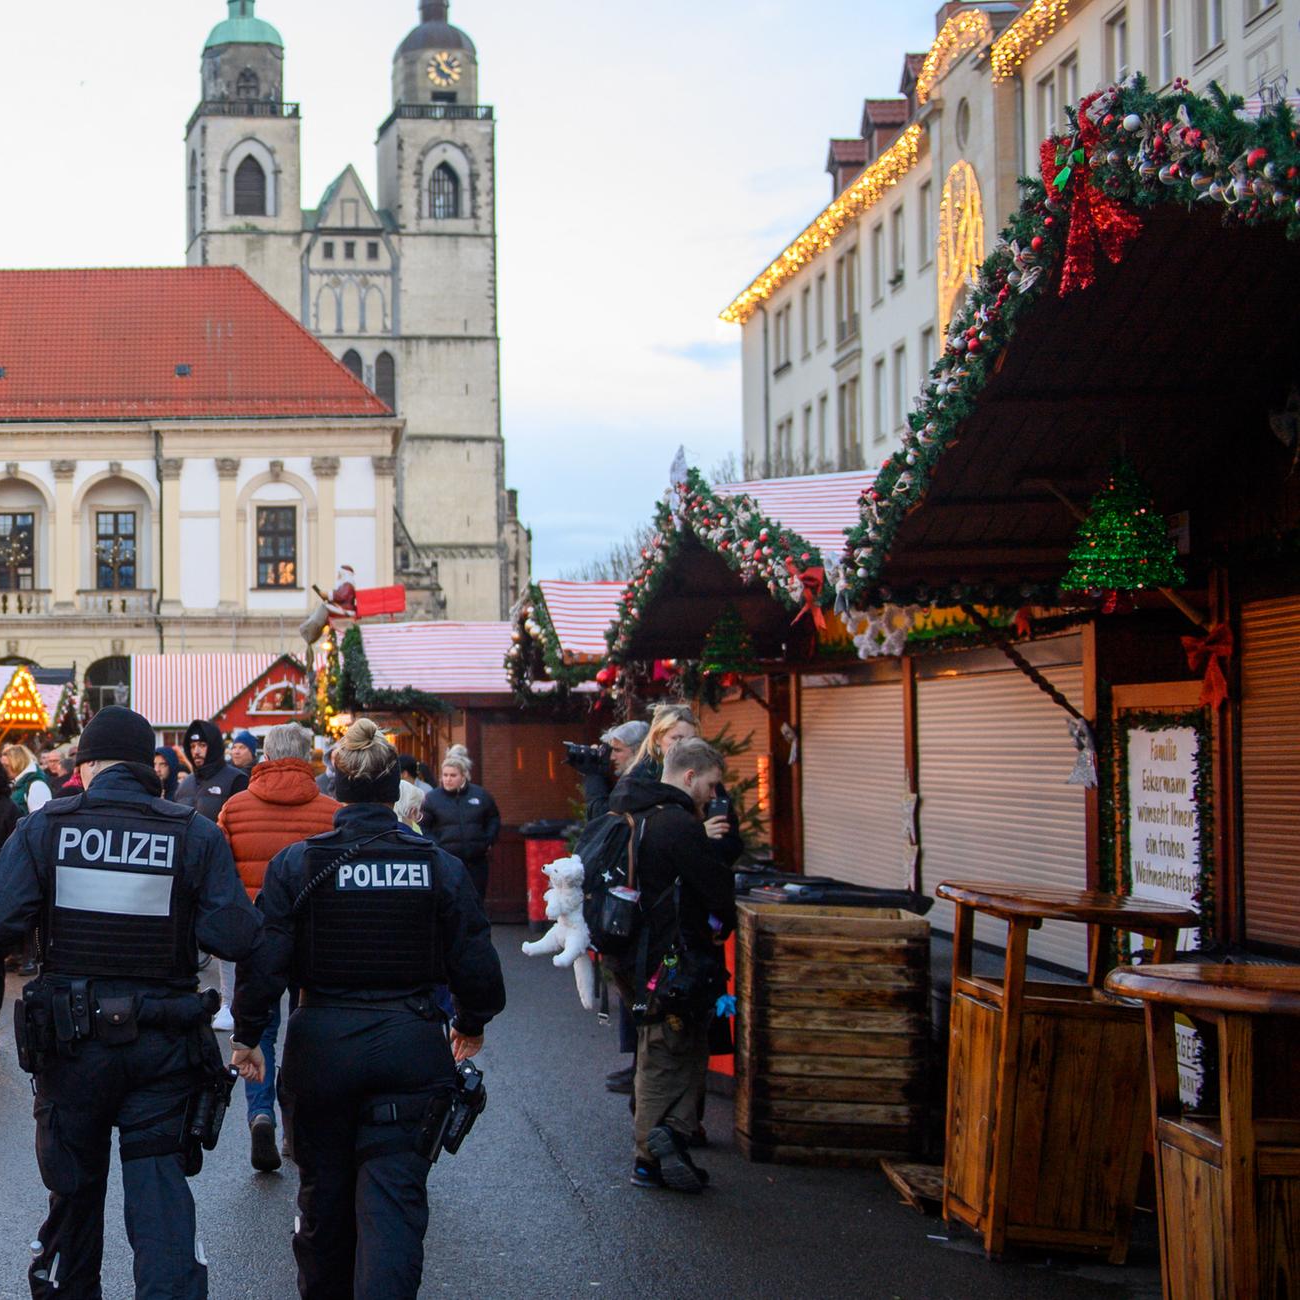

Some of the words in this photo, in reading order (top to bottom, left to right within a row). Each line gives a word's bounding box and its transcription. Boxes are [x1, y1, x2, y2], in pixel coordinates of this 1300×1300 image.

[1150, 737, 1177, 761] Familie
[1142, 768, 1187, 795] Eckermann
[1137, 800, 1169, 825] wünscht
[1170, 801, 1194, 828] Ihnen
[58, 827, 175, 869] POLIZEI
[1146, 832, 1158, 854] ein
[1158, 831, 1186, 859] frohes
[338, 863, 430, 887] POLIZEI
